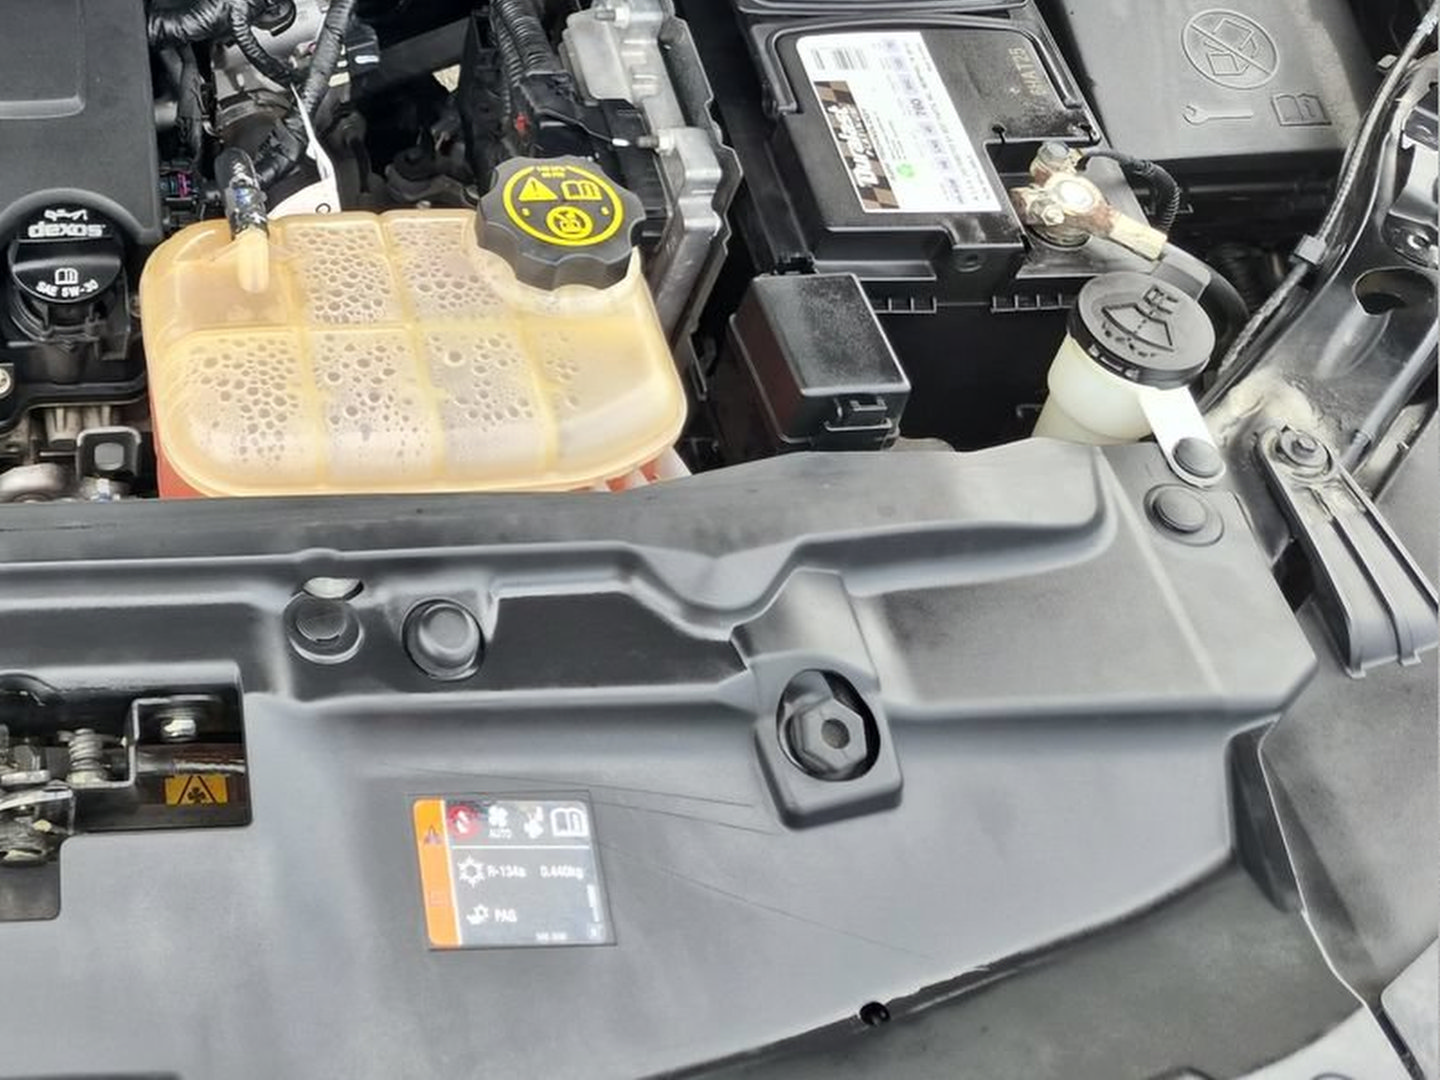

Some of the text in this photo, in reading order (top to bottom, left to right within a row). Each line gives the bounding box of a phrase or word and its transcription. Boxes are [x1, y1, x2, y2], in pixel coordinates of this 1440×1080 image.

[27, 220, 103, 239] dexos
[35, 279, 99, 298] SAE 5W-30
[487, 865, 527, 879] R-134a
[494, 908, 518, 923] PAG
